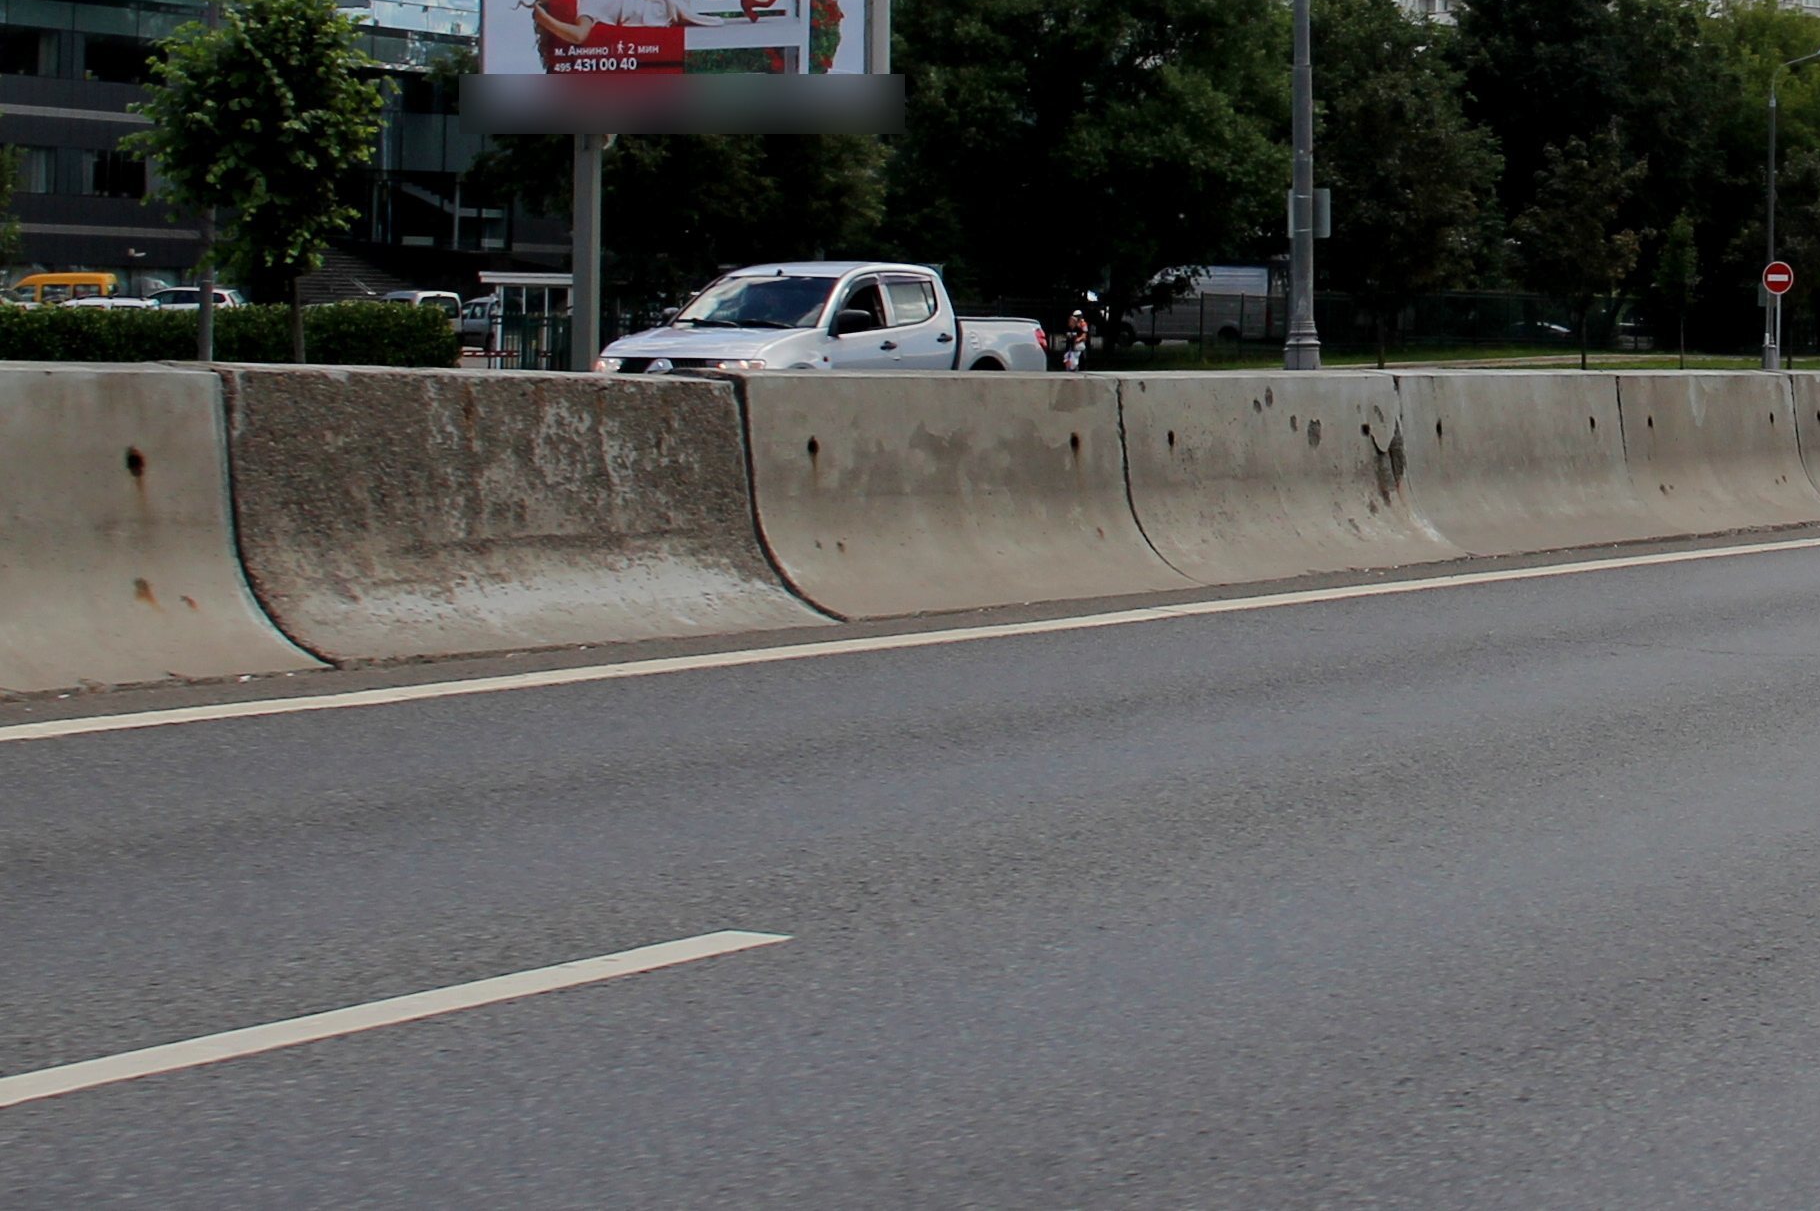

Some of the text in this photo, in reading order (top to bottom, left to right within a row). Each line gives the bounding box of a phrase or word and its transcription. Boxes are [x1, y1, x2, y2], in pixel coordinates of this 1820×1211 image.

[568, 45, 609, 56] Аннино
[628, 43, 635, 54] 2
[638, 45, 660, 54] мин
[554, 57, 638, 72] 495 431 00 40
